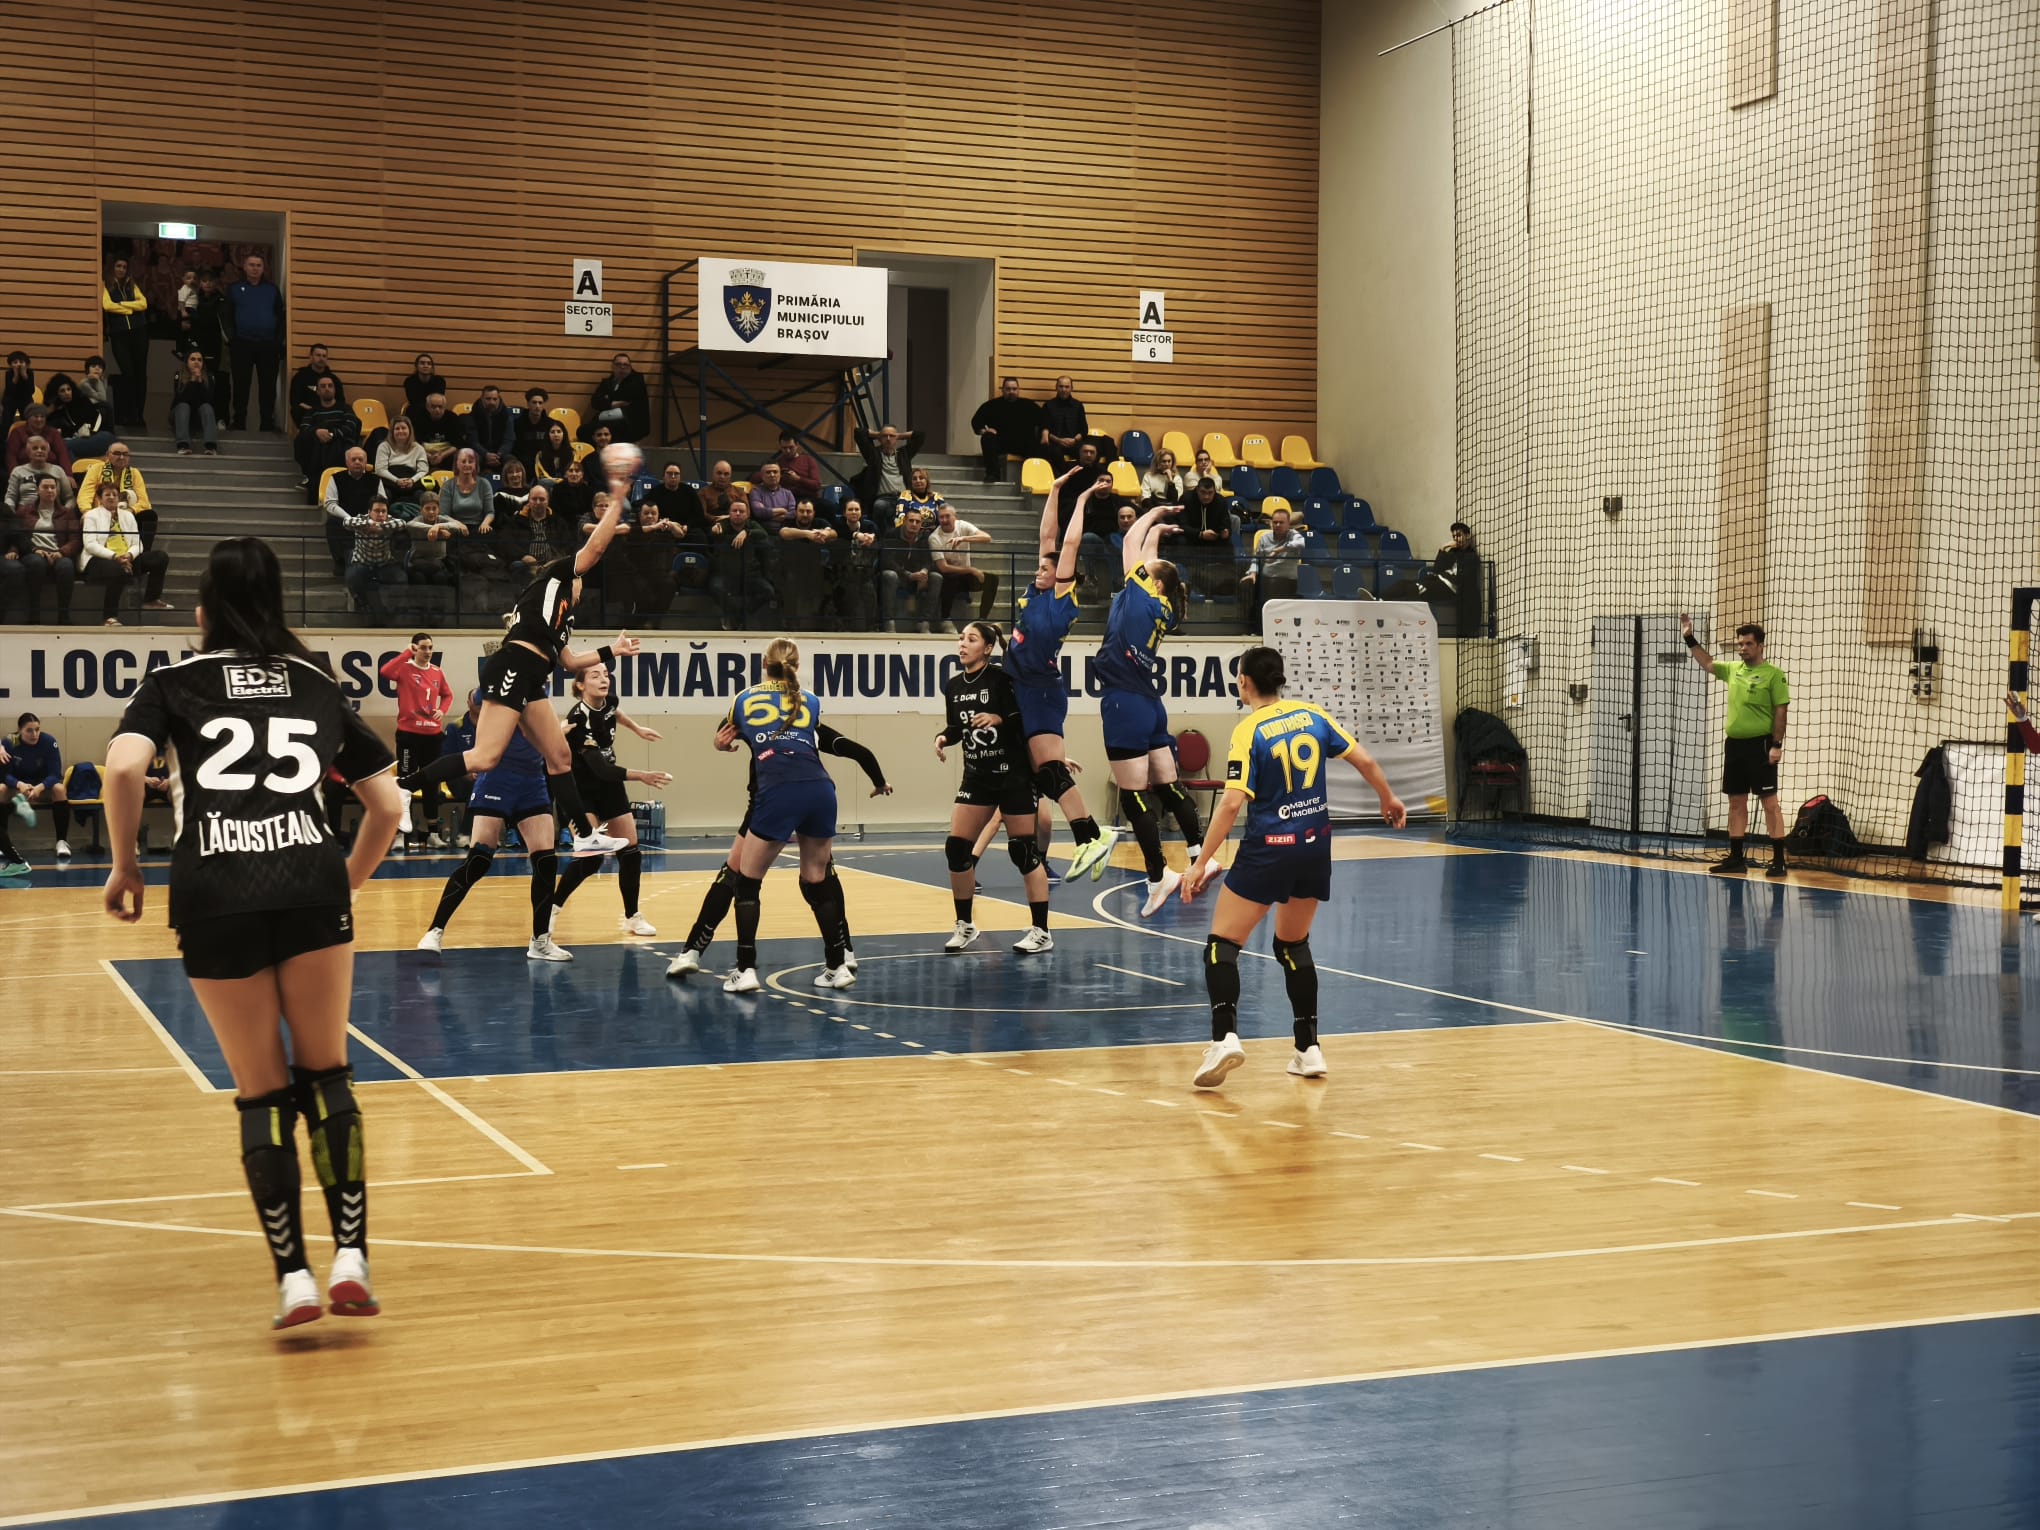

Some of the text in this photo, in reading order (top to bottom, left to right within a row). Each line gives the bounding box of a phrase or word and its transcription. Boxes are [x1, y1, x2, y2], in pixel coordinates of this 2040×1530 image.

[577, 271, 599, 295] A
[778, 294, 840, 308] PRIMĂRIA
[567, 306, 611, 316] SECTOR
[1143, 302, 1161, 325] A
[585, 320, 593, 332] 5
[778, 312, 864, 326] MUNICIPIULUI
[778, 329, 829, 342] BRAȘOV
[1134, 334, 1171, 343] SECTOR
[1150, 348, 1156, 358] 6
[230, 665, 284, 686] EDS
[232, 684, 286, 697] Electric
[196, 717, 321, 793] 25
[1270, 733, 1320, 794] 19
